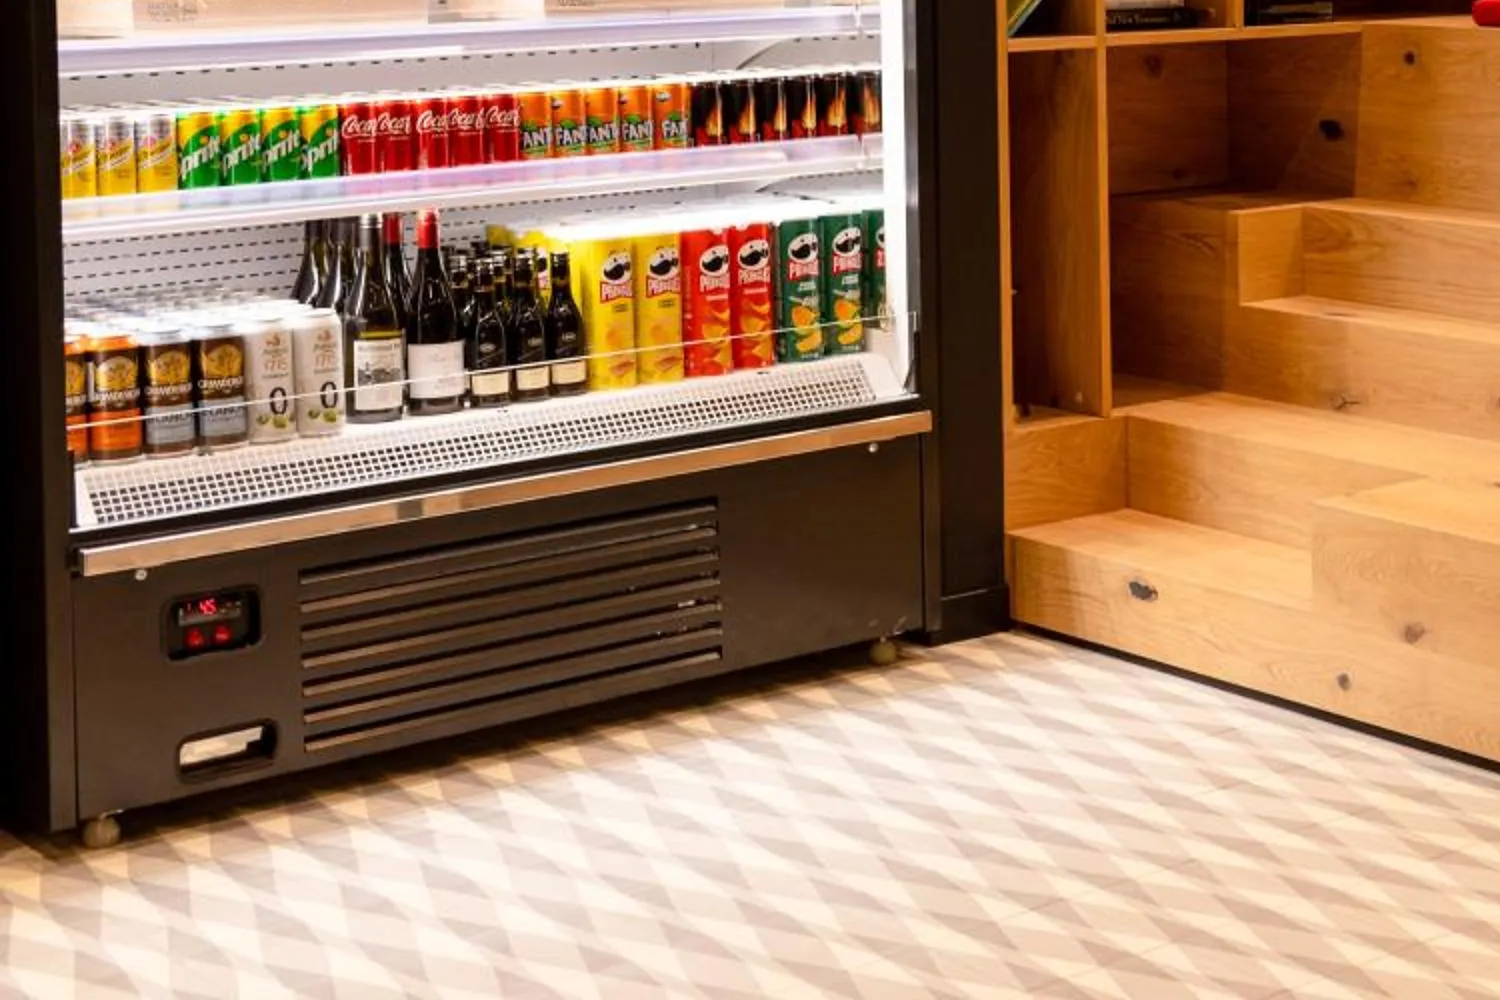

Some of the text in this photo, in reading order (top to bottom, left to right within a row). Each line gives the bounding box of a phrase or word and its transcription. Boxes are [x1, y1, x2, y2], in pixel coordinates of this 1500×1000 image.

[555, 125, 587, 145] FANT
[621, 120, 653, 140] FANT
[269, 386, 288, 415] 0
[320, 381, 338, 409] 0
